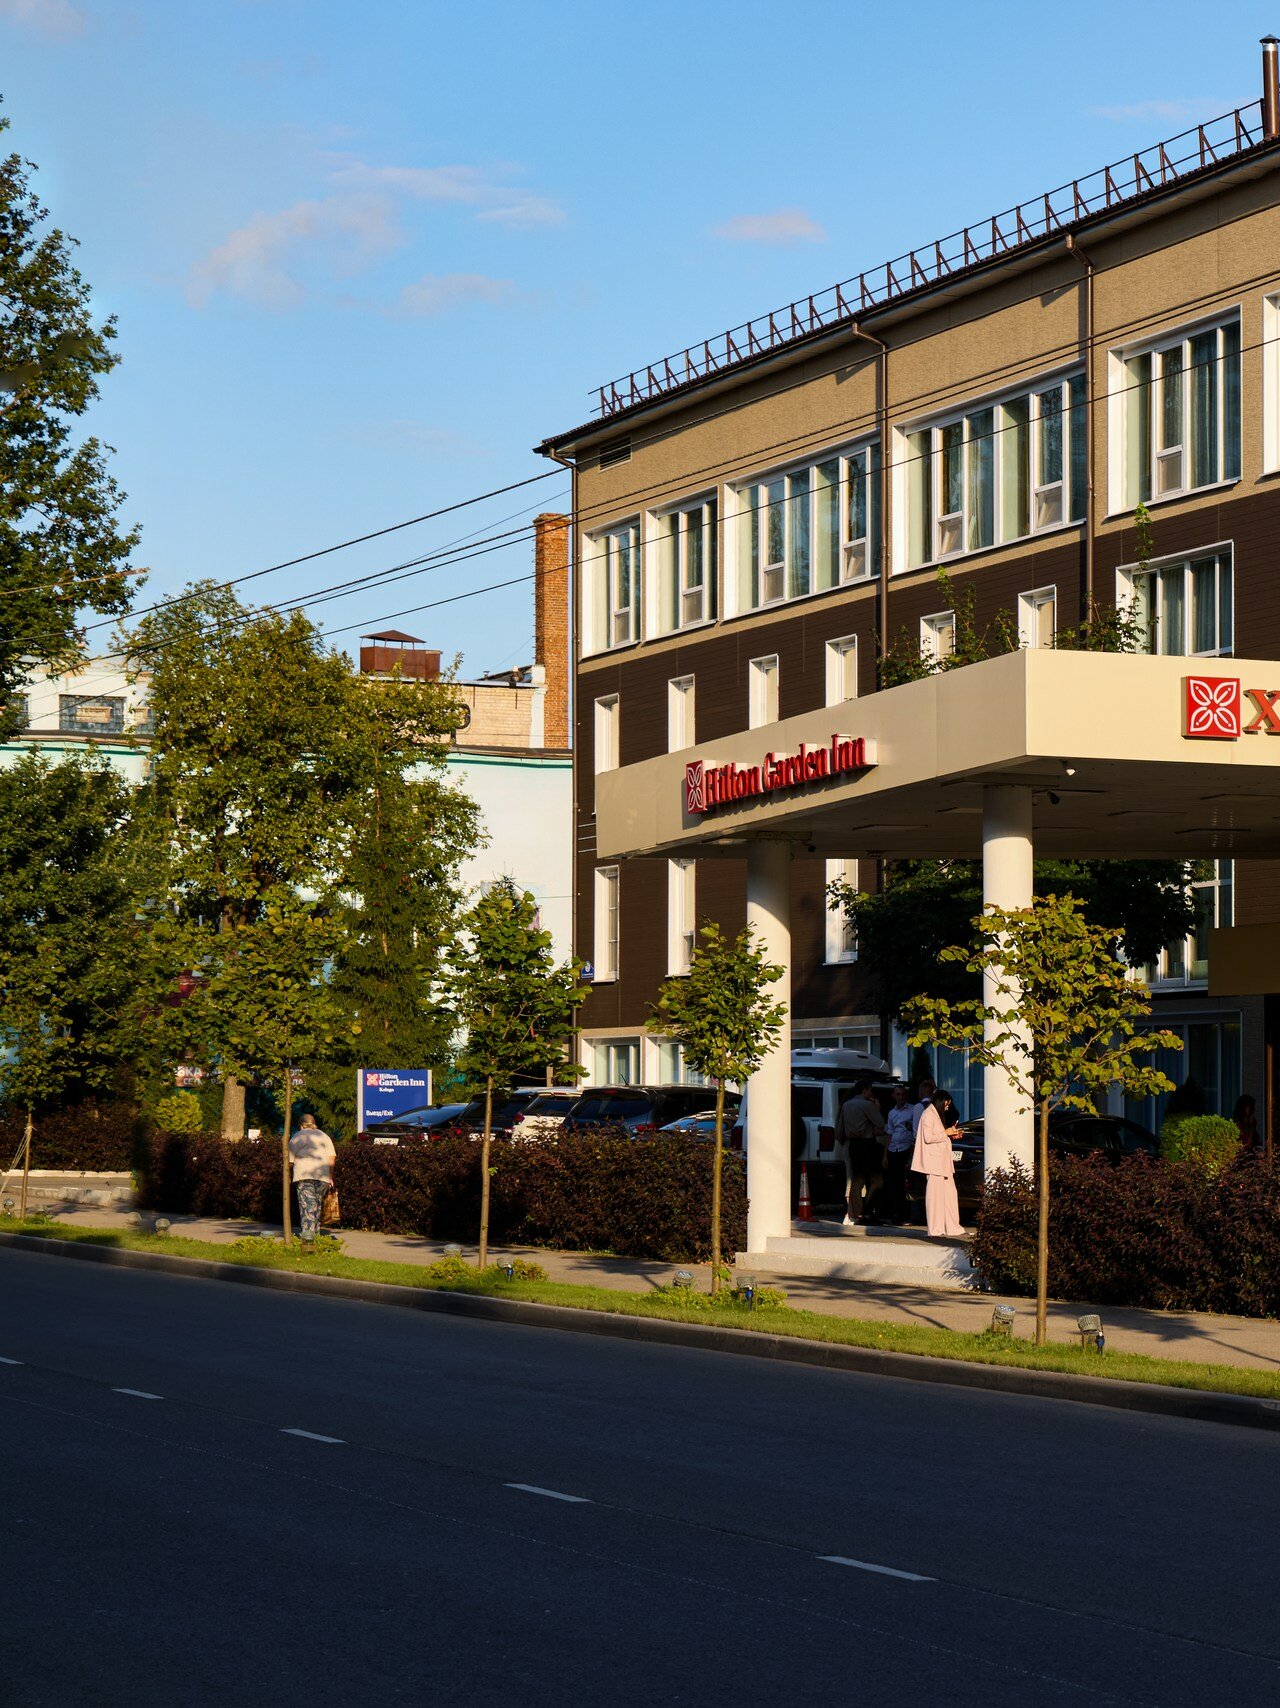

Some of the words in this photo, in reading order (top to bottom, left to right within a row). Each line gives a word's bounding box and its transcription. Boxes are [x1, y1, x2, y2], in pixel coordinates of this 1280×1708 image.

[705, 762, 764, 806] Hilton
[763, 742, 830, 791] Garden
[831, 733, 867, 772] Inn
[379, 1078, 409, 1086] Garden
[410, 1078, 425, 1086] Inn
